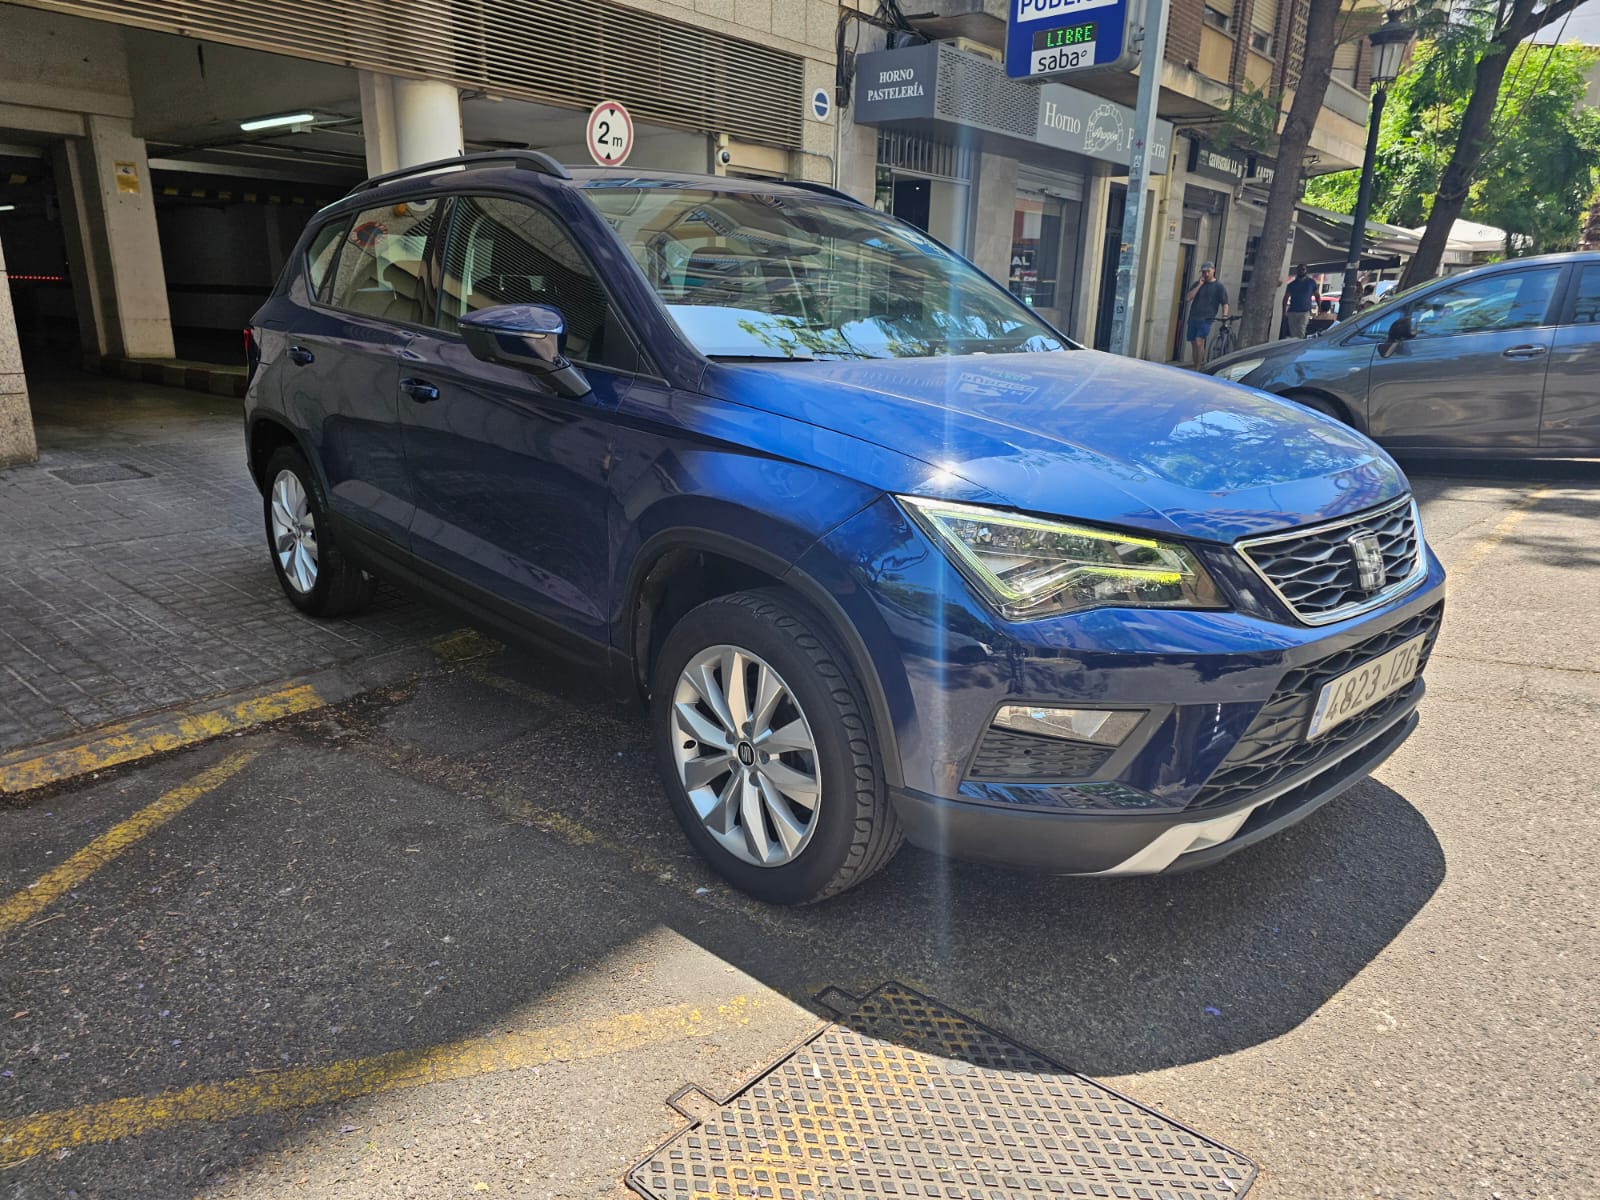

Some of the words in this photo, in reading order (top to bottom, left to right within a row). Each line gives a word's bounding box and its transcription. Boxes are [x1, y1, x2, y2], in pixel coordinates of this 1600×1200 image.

[1047, 25, 1093, 47] LIBRE
[879, 68, 914, 83] HORNO
[867, 81, 925, 102] PASTELERÍA
[1044, 101, 1081, 135] Horno
[597, 121, 610, 145] 2
[612, 136, 623, 148] m
[1324, 663, 1382, 721] 4823
[1382, 643, 1418, 692] JZG
